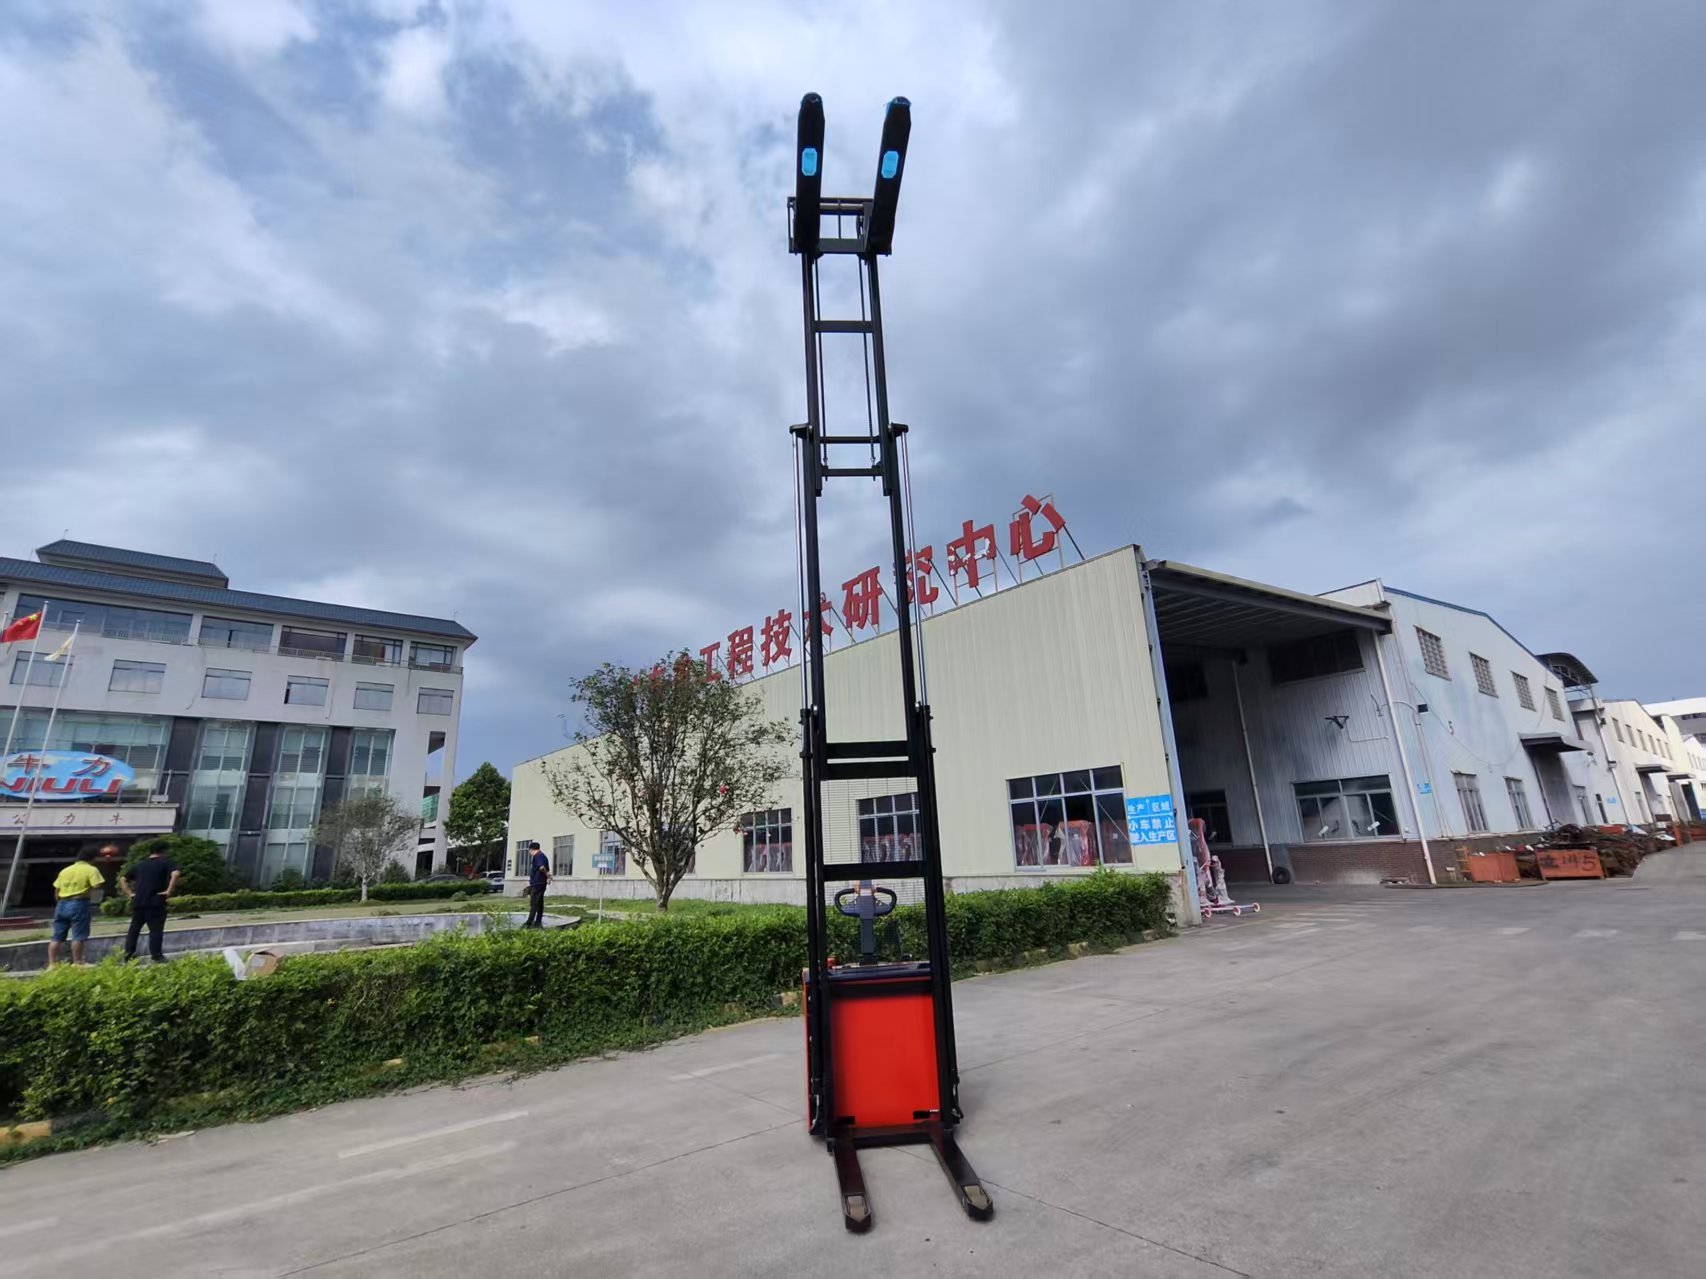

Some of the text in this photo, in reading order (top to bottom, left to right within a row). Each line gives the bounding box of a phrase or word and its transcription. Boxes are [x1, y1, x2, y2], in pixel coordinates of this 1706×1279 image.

[631, 494, 1066, 684] 工程技术研究中心
[7, 753, 112, 777] 牛力
